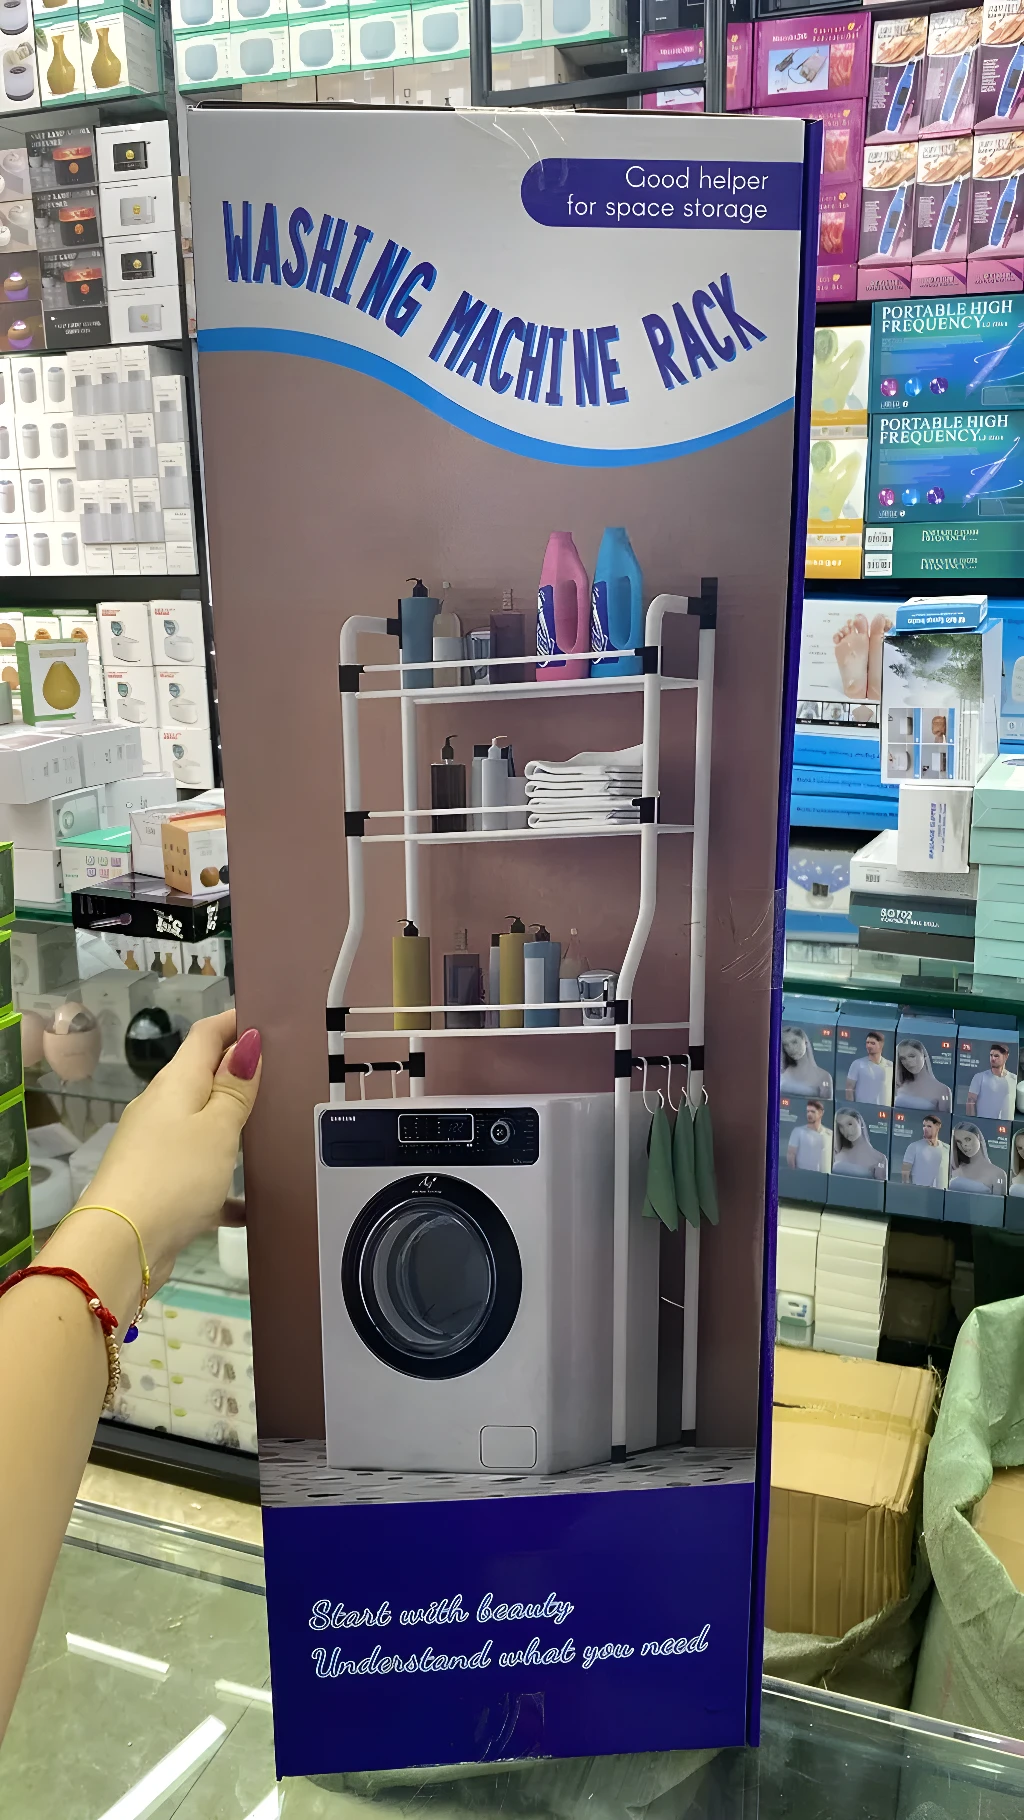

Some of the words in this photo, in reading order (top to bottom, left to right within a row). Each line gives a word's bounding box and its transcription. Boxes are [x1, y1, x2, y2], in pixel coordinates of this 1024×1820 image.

[625, 165, 690, 189] Good
[699, 165, 769, 195] helper
[566, 193, 597, 216] for
[605, 201, 675, 222] space
[683, 198, 768, 224] storage
[222, 200, 438, 338] WASHING
[428, 290, 630, 407] MACHINE
[641, 272, 768, 391] RACK
[882, 303, 967, 320] PORTABLE
[970, 300, 1013, 315] HIGH
[882, 314, 985, 333] FREQUENCY
[880, 416, 963, 431] PORTABLE
[967, 414, 1009, 428] HIGH
[880, 428, 981, 446] FREQUENCY
[308, 1599, 392, 1631] Start
[399, 1593, 470, 1625] with
[476, 1592, 575, 1624] beauty
[311, 1639, 493, 1678] Understand
[498, 1636, 576, 1667] what
[582, 1640, 635, 1669] you
[640, 1623, 711, 1657] need
